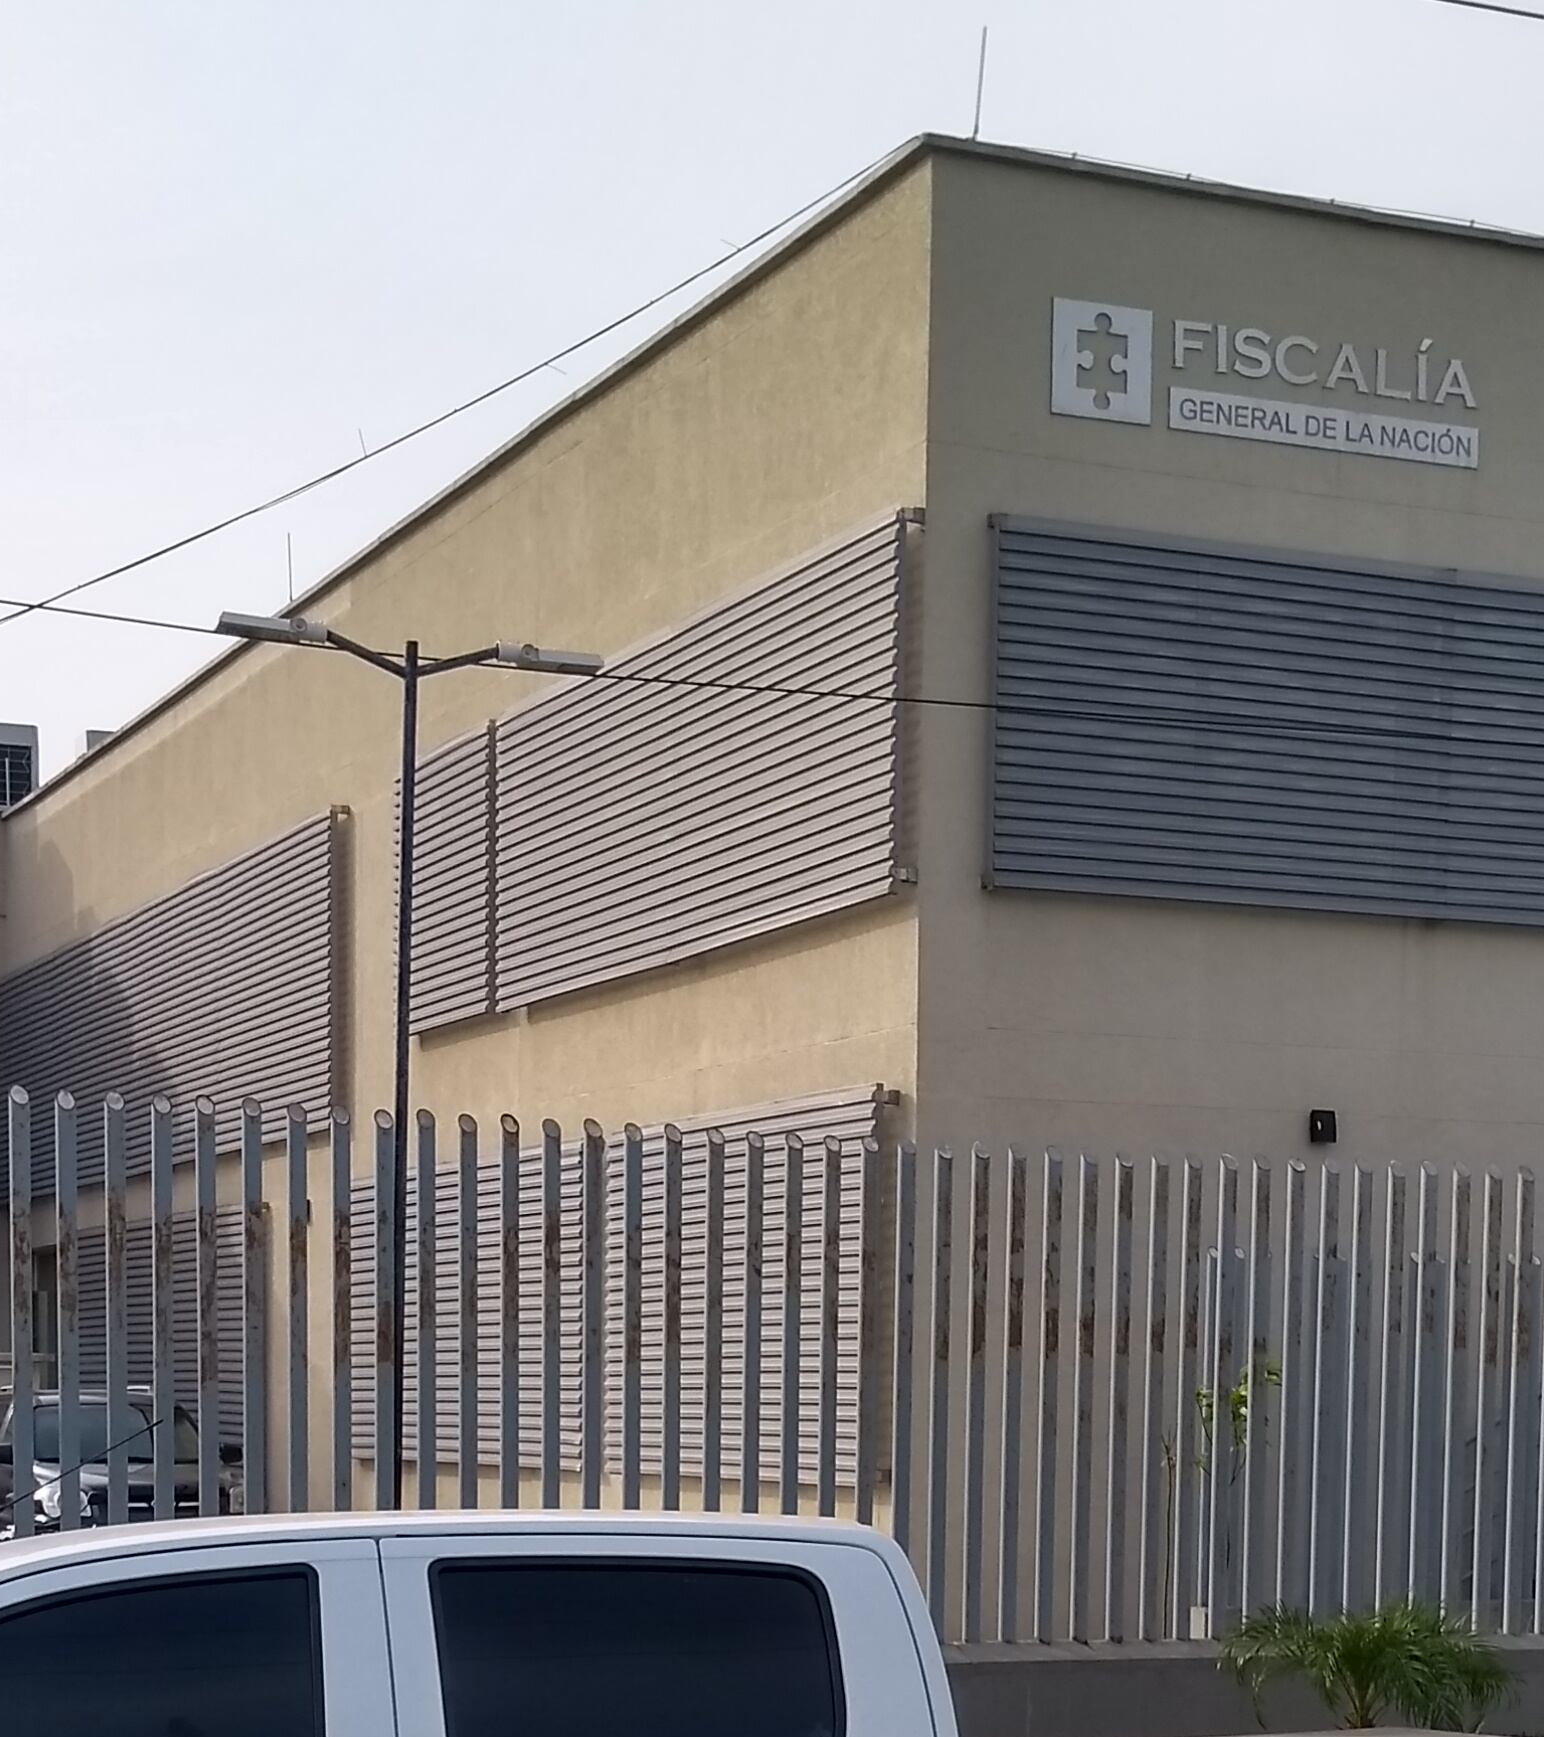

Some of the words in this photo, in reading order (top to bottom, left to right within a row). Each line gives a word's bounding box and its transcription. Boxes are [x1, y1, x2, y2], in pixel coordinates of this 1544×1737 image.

[1172, 319, 1478, 410] FISCALÍA
[1178, 397, 1298, 436] GENERAL
[1304, 415, 1337, 441] DE
[1345, 420, 1375, 447] LA
[1379, 423, 1473, 459] NACIÓN
